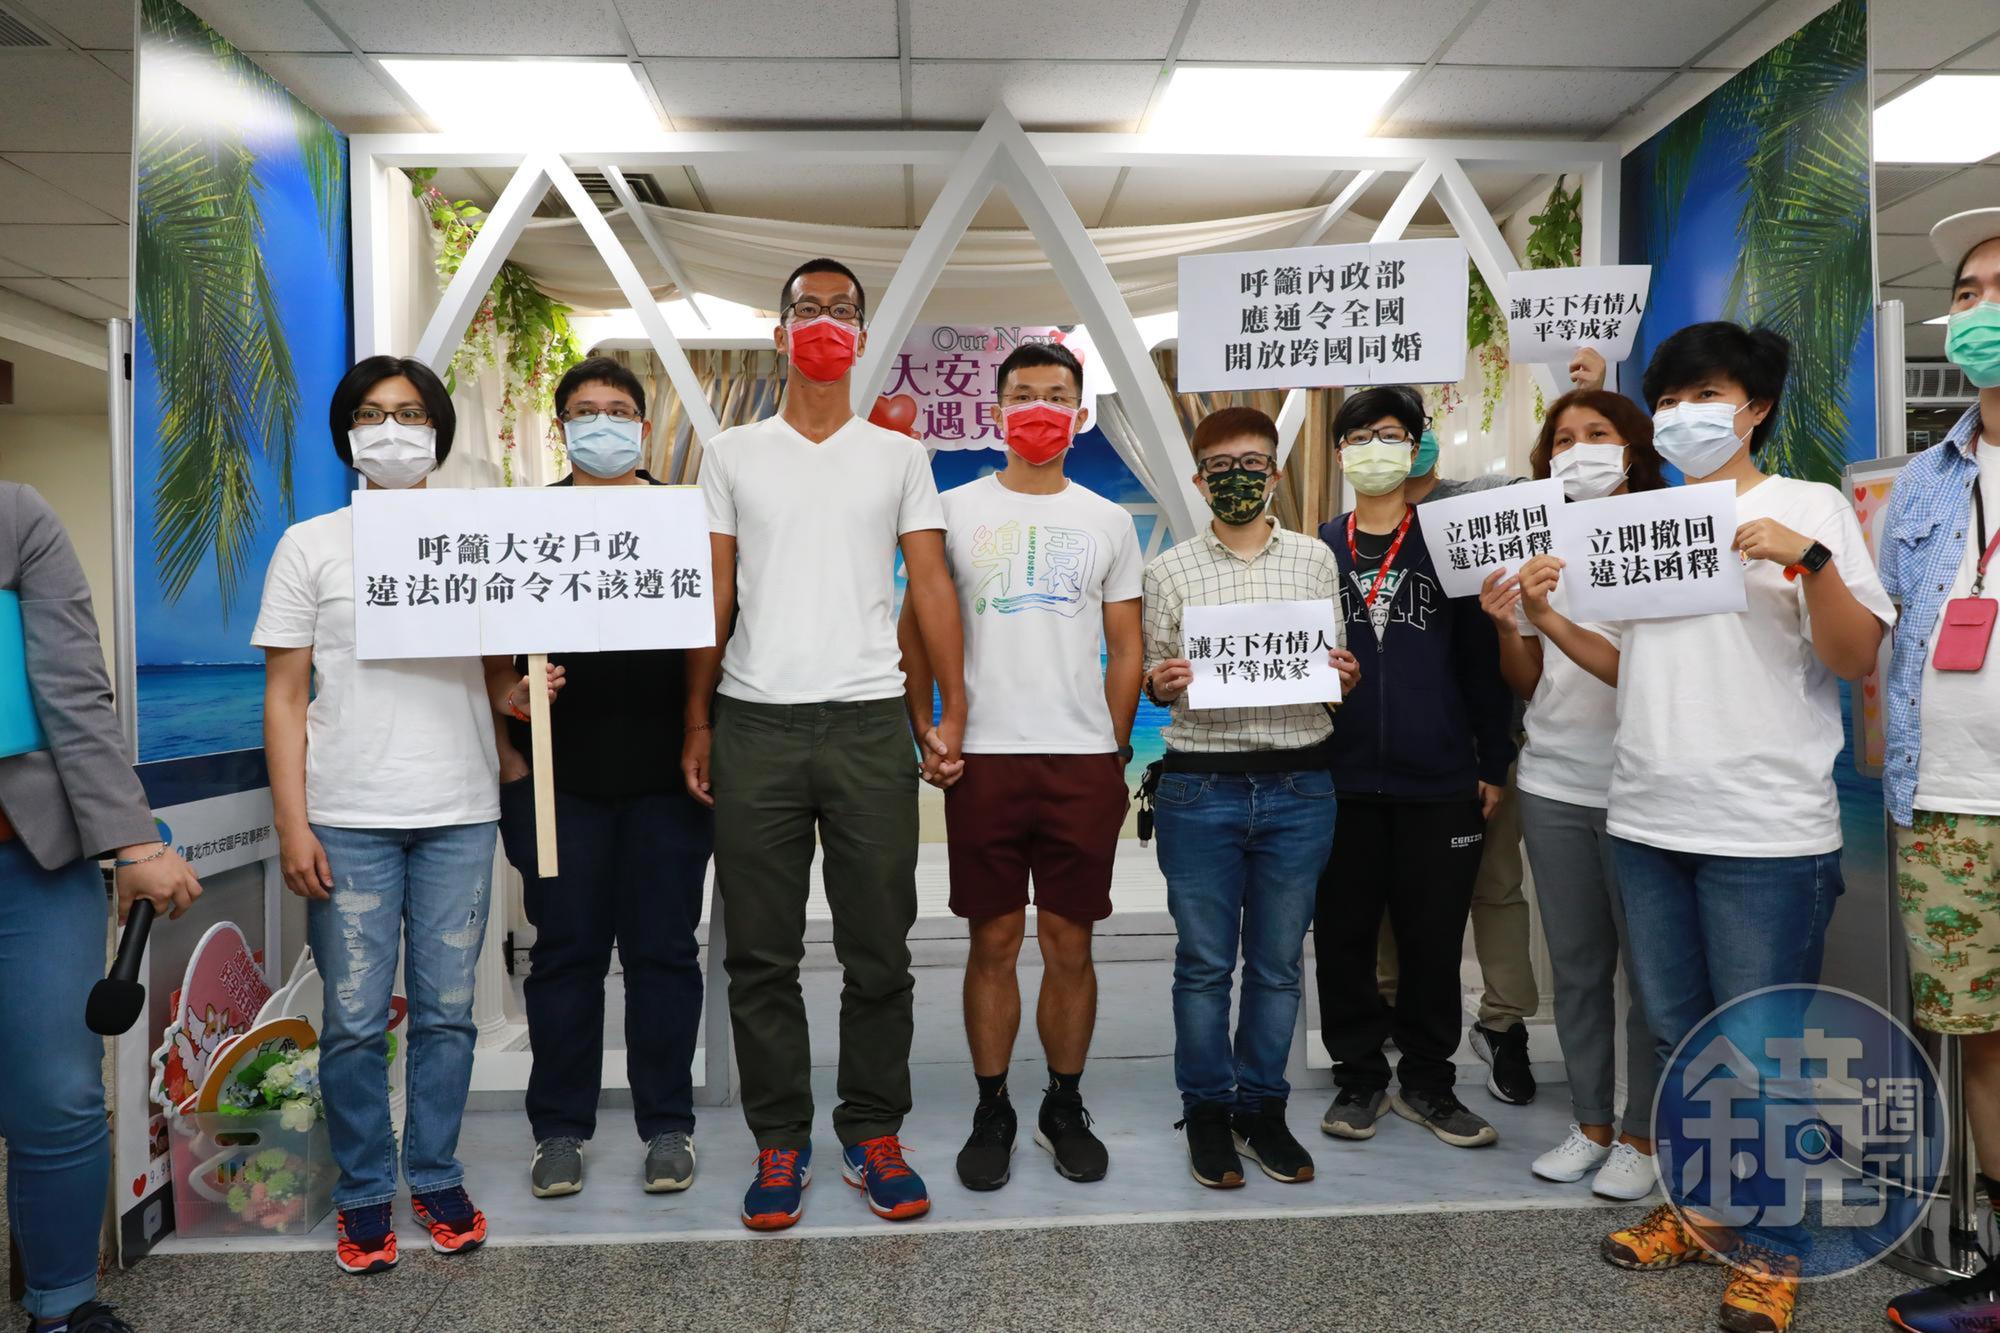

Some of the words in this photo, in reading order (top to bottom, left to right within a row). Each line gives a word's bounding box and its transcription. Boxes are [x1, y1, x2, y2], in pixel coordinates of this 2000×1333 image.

[1240, 260, 1406, 298] 呼籲內政部
[1240, 297, 1404, 335] 應通令全國
[1510, 293, 1642, 320] 讓天下有情人
[932, 326, 988, 351] Our
[1533, 318, 1622, 342] 平等成家
[1225, 332, 1422, 372] 開放跨國同婚
[1443, 504, 1549, 546] 立即撤回
[1586, 515, 1715, 557] 立即撤回
[418, 531, 641, 566] 呼籲大安戶政
[1026, 526, 1037, 587] CHAMPIONSHIP
[1447, 529, 1554, 571] 違法函釋
[1590, 547, 1720, 588] 違法函釋
[366, 568, 703, 607] 違法的命令不該遵從
[1188, 630, 1334, 660] 讓天下有情人
[1213, 657, 1311, 684] 平等成家
